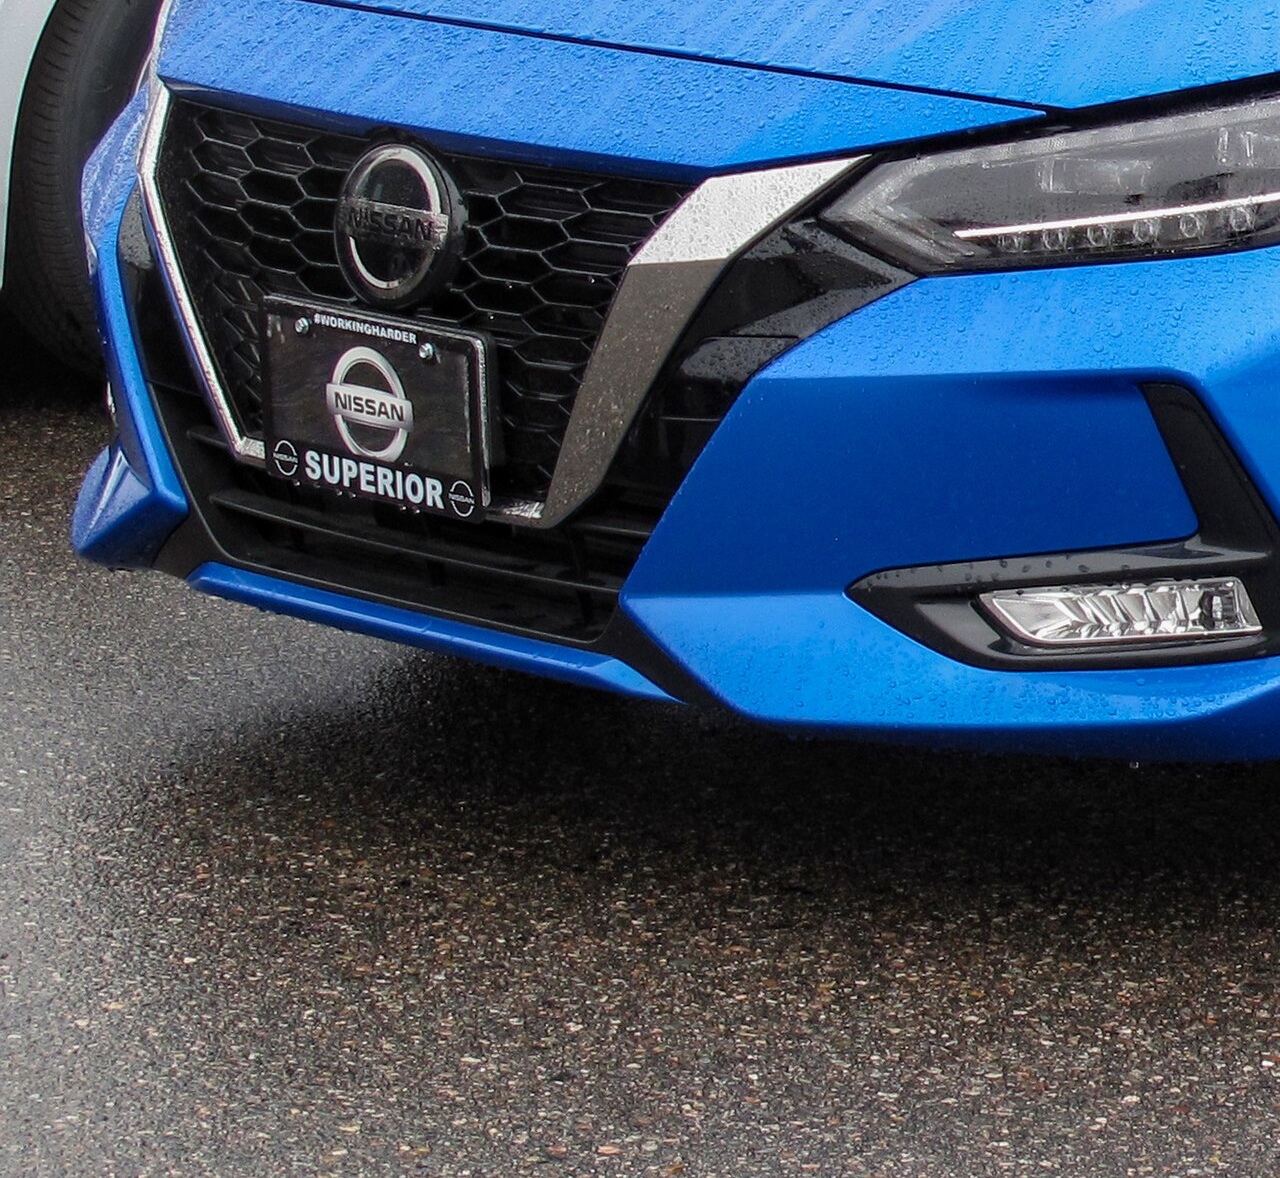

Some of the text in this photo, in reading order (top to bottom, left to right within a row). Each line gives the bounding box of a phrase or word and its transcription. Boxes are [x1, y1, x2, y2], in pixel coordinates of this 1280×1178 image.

[313, 313, 417, 345] #WORKINGHARDER
[334, 391, 405, 422] NISSAN
[304, 449, 445, 510] SUPERIOR
